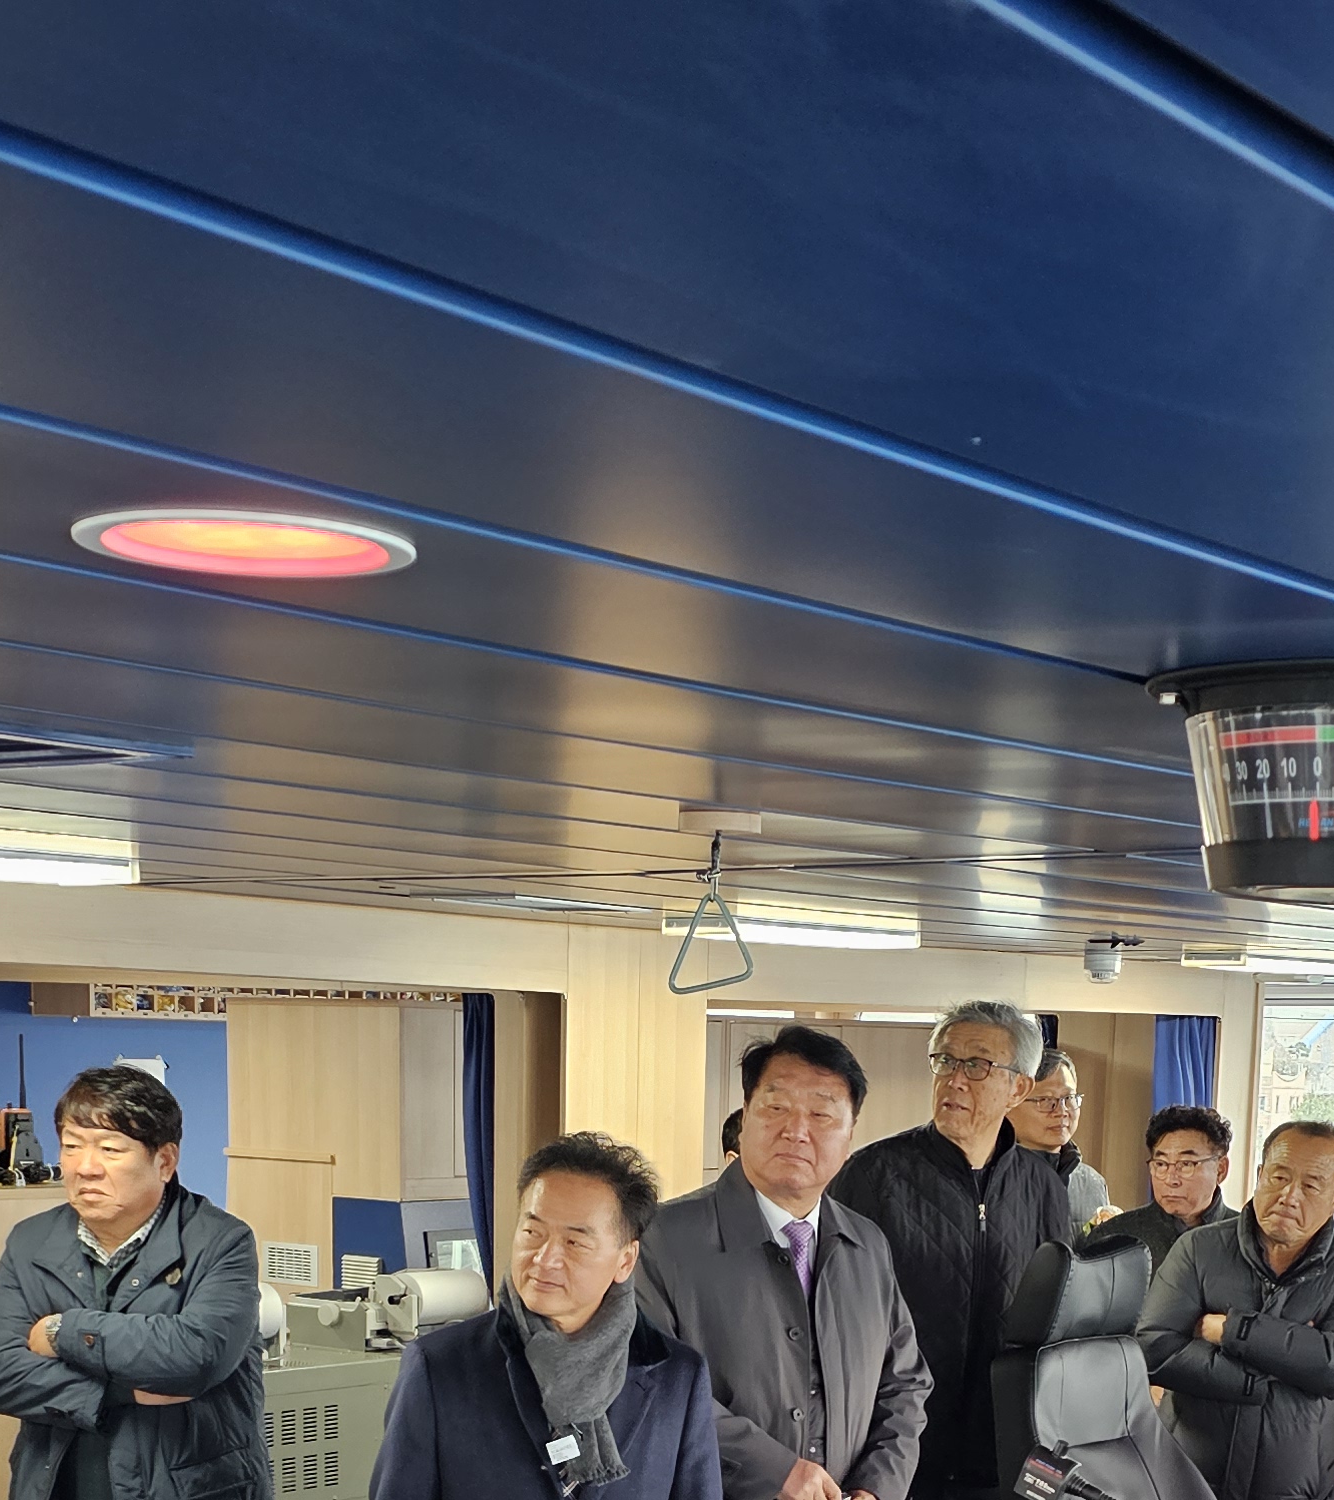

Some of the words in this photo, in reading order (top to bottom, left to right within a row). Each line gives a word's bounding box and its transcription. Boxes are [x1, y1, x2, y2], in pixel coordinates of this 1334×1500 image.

[1235, 760, 1248, 781] 30
[1255, 758, 1271, 780] 20
[1281, 756, 1297, 778] 10
[1312, 755, 1323, 778] 0
